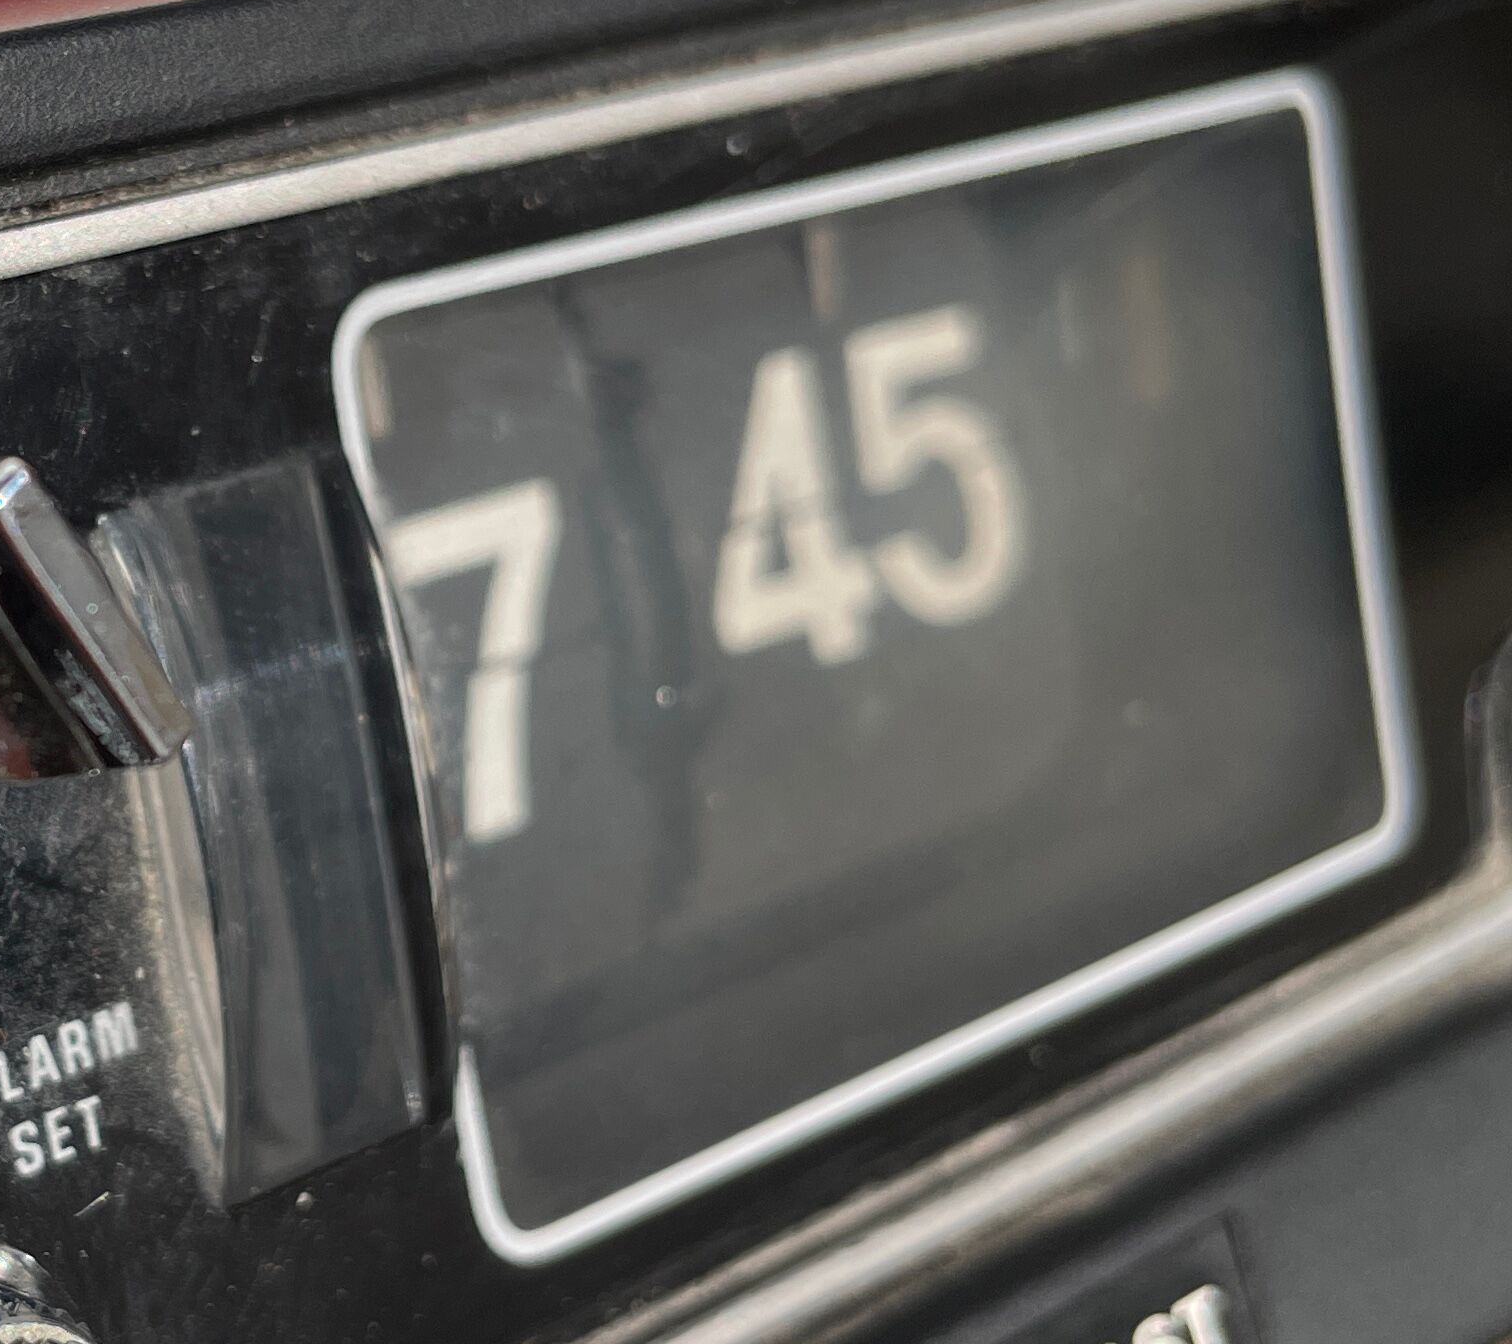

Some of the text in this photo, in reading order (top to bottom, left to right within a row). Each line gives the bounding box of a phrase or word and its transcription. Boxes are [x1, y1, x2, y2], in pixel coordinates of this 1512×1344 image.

[381, 306, 1022, 843] 7 45
[12, 1095, 104, 1177] SET
